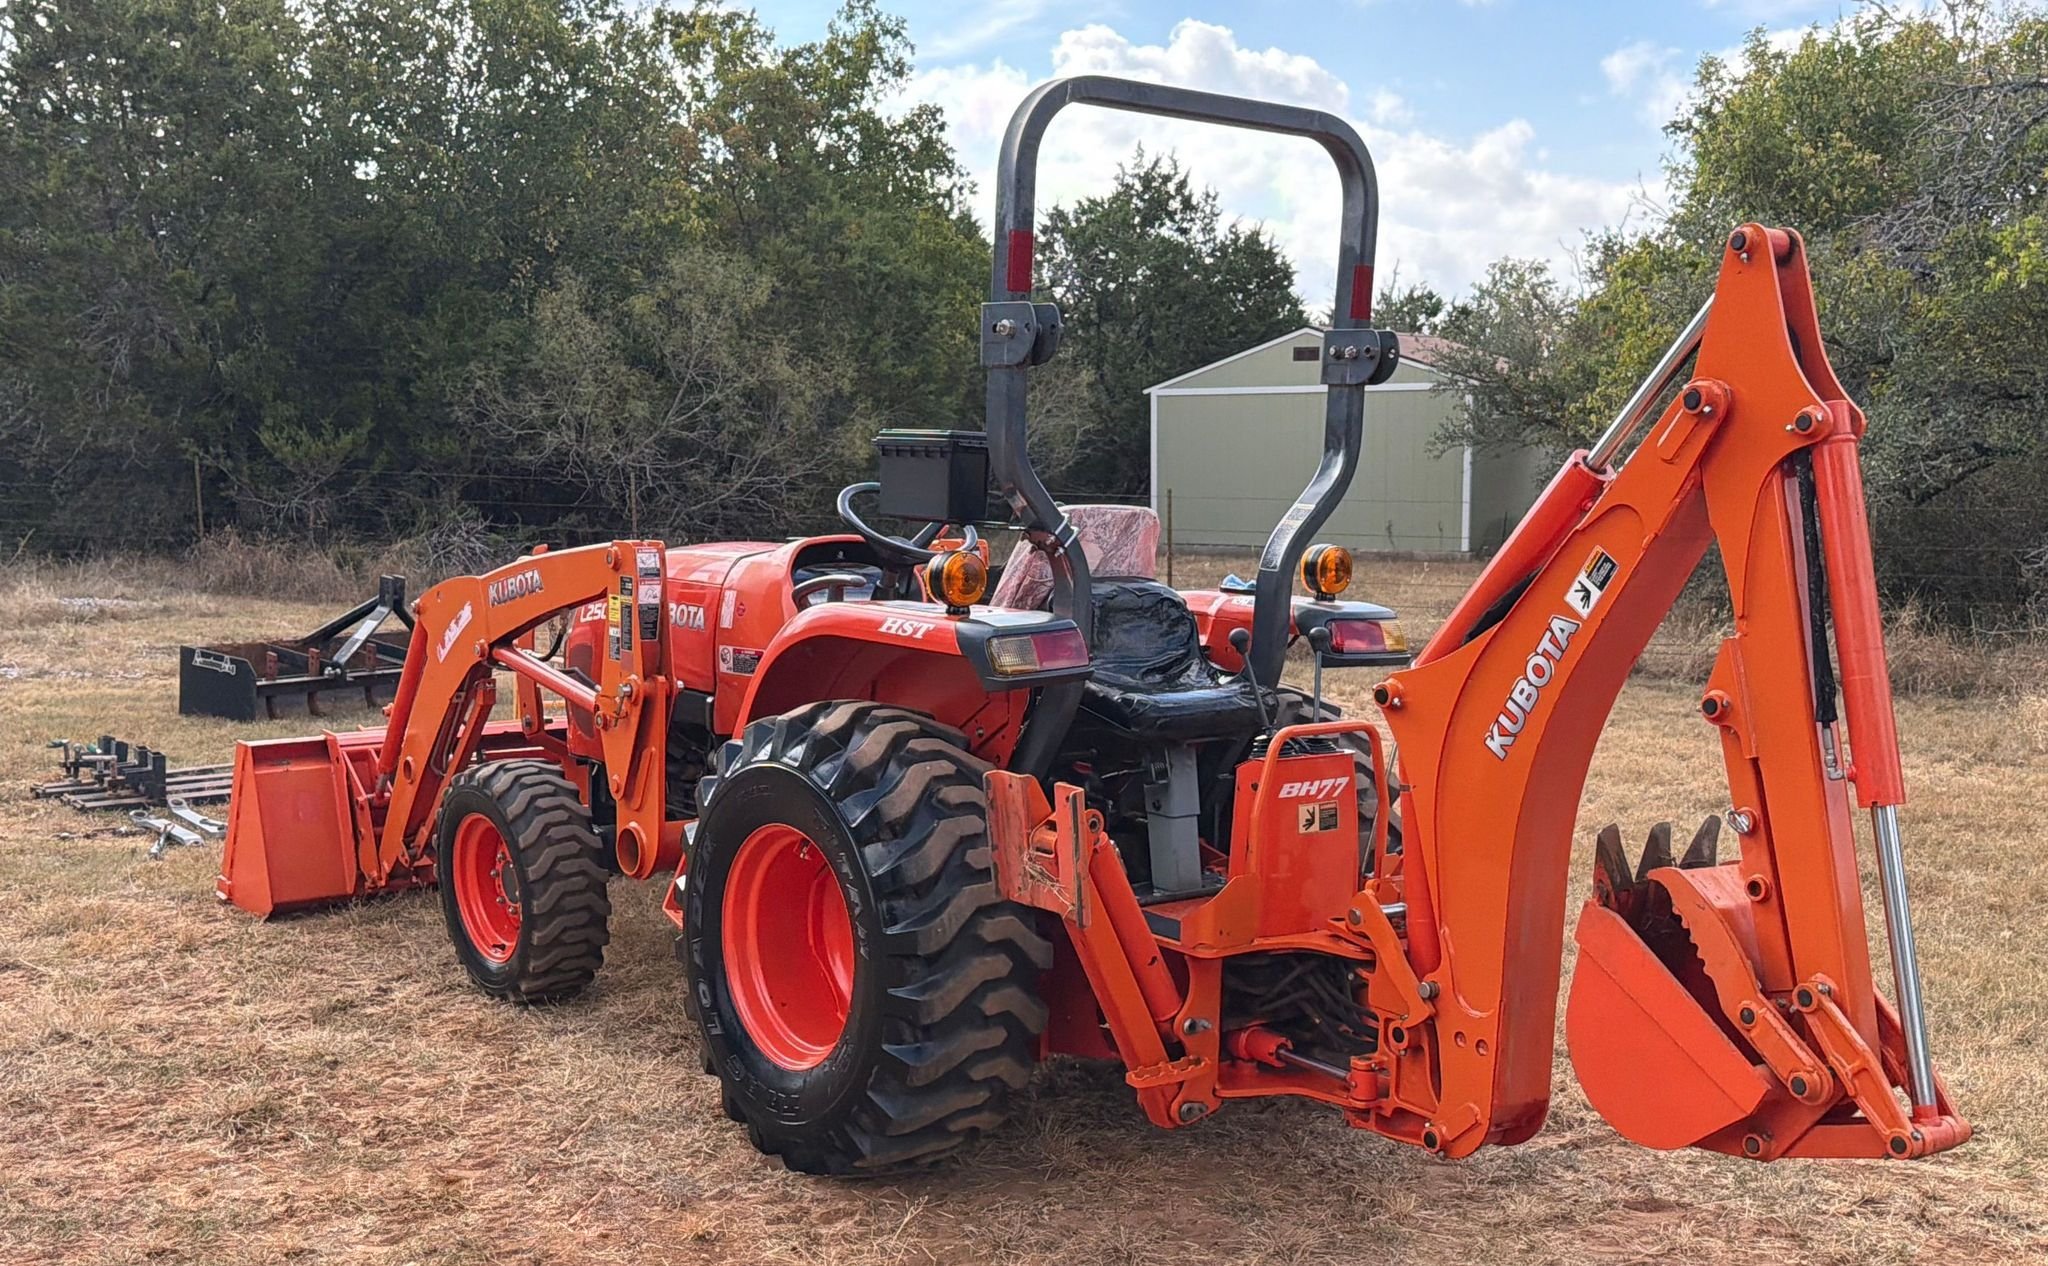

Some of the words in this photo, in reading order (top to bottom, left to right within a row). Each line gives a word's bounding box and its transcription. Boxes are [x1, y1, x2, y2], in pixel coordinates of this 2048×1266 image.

[488, 569, 544, 608] KUBOTA
[878, 616, 935, 639] HST
[1484, 616, 1580, 761] KUBOTA
[1278, 776, 1350, 799] BH77
